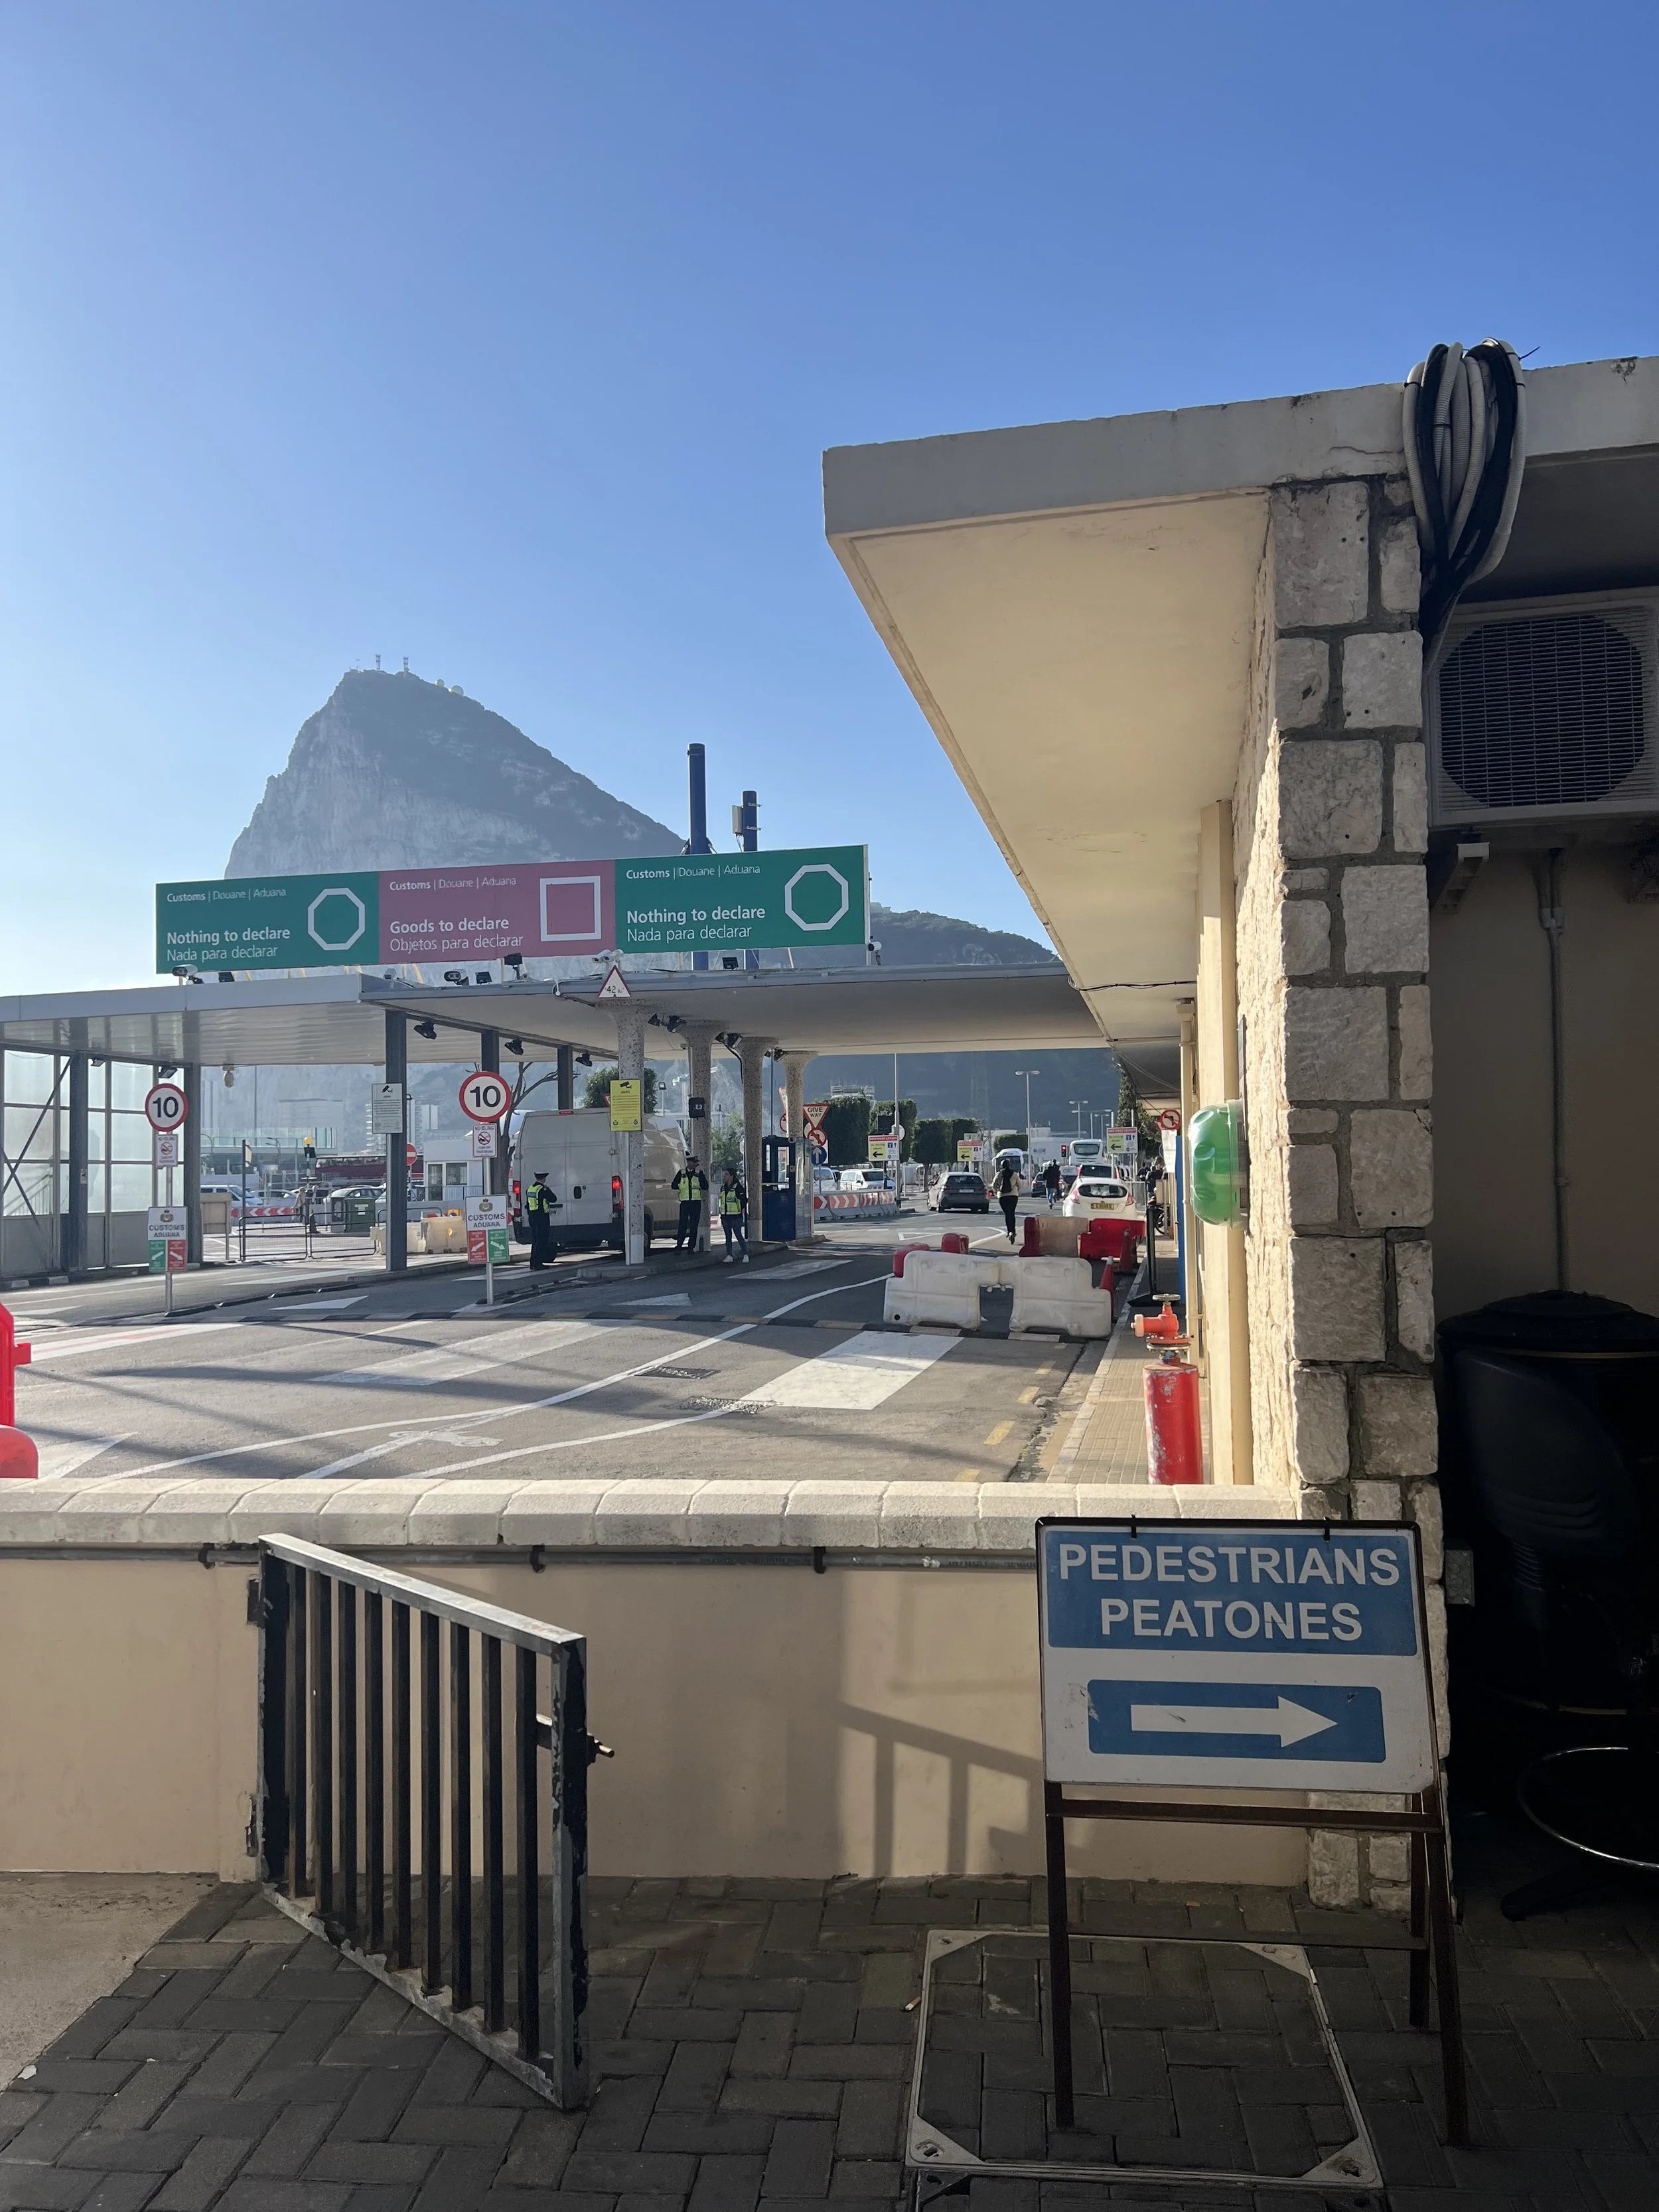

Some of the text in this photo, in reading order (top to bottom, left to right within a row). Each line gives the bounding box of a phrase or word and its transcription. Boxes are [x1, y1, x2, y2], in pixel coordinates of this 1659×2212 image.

[626, 865, 760, 879] Customs Douane Aduana
[390, 877, 517, 891] Customs Douane Aduana
[167, 888, 286, 903] Customs Douane Aduana
[627, 905, 765, 925] Nothing to declare
[390, 917, 509, 934] Goods to declare
[627, 924, 752, 944] Nada para declarar
[167, 926, 290, 946] Nothing to declare
[390, 934, 523, 954] Objetos para declarar
[167, 945, 278, 962] Nada para declarar
[470, 1085, 501, 1108] 10
[152, 1096, 179, 1118] 10
[1059, 1543, 1400, 1586] PEDESTRIANS
[1101, 1598, 1363, 1642] PEATONES
